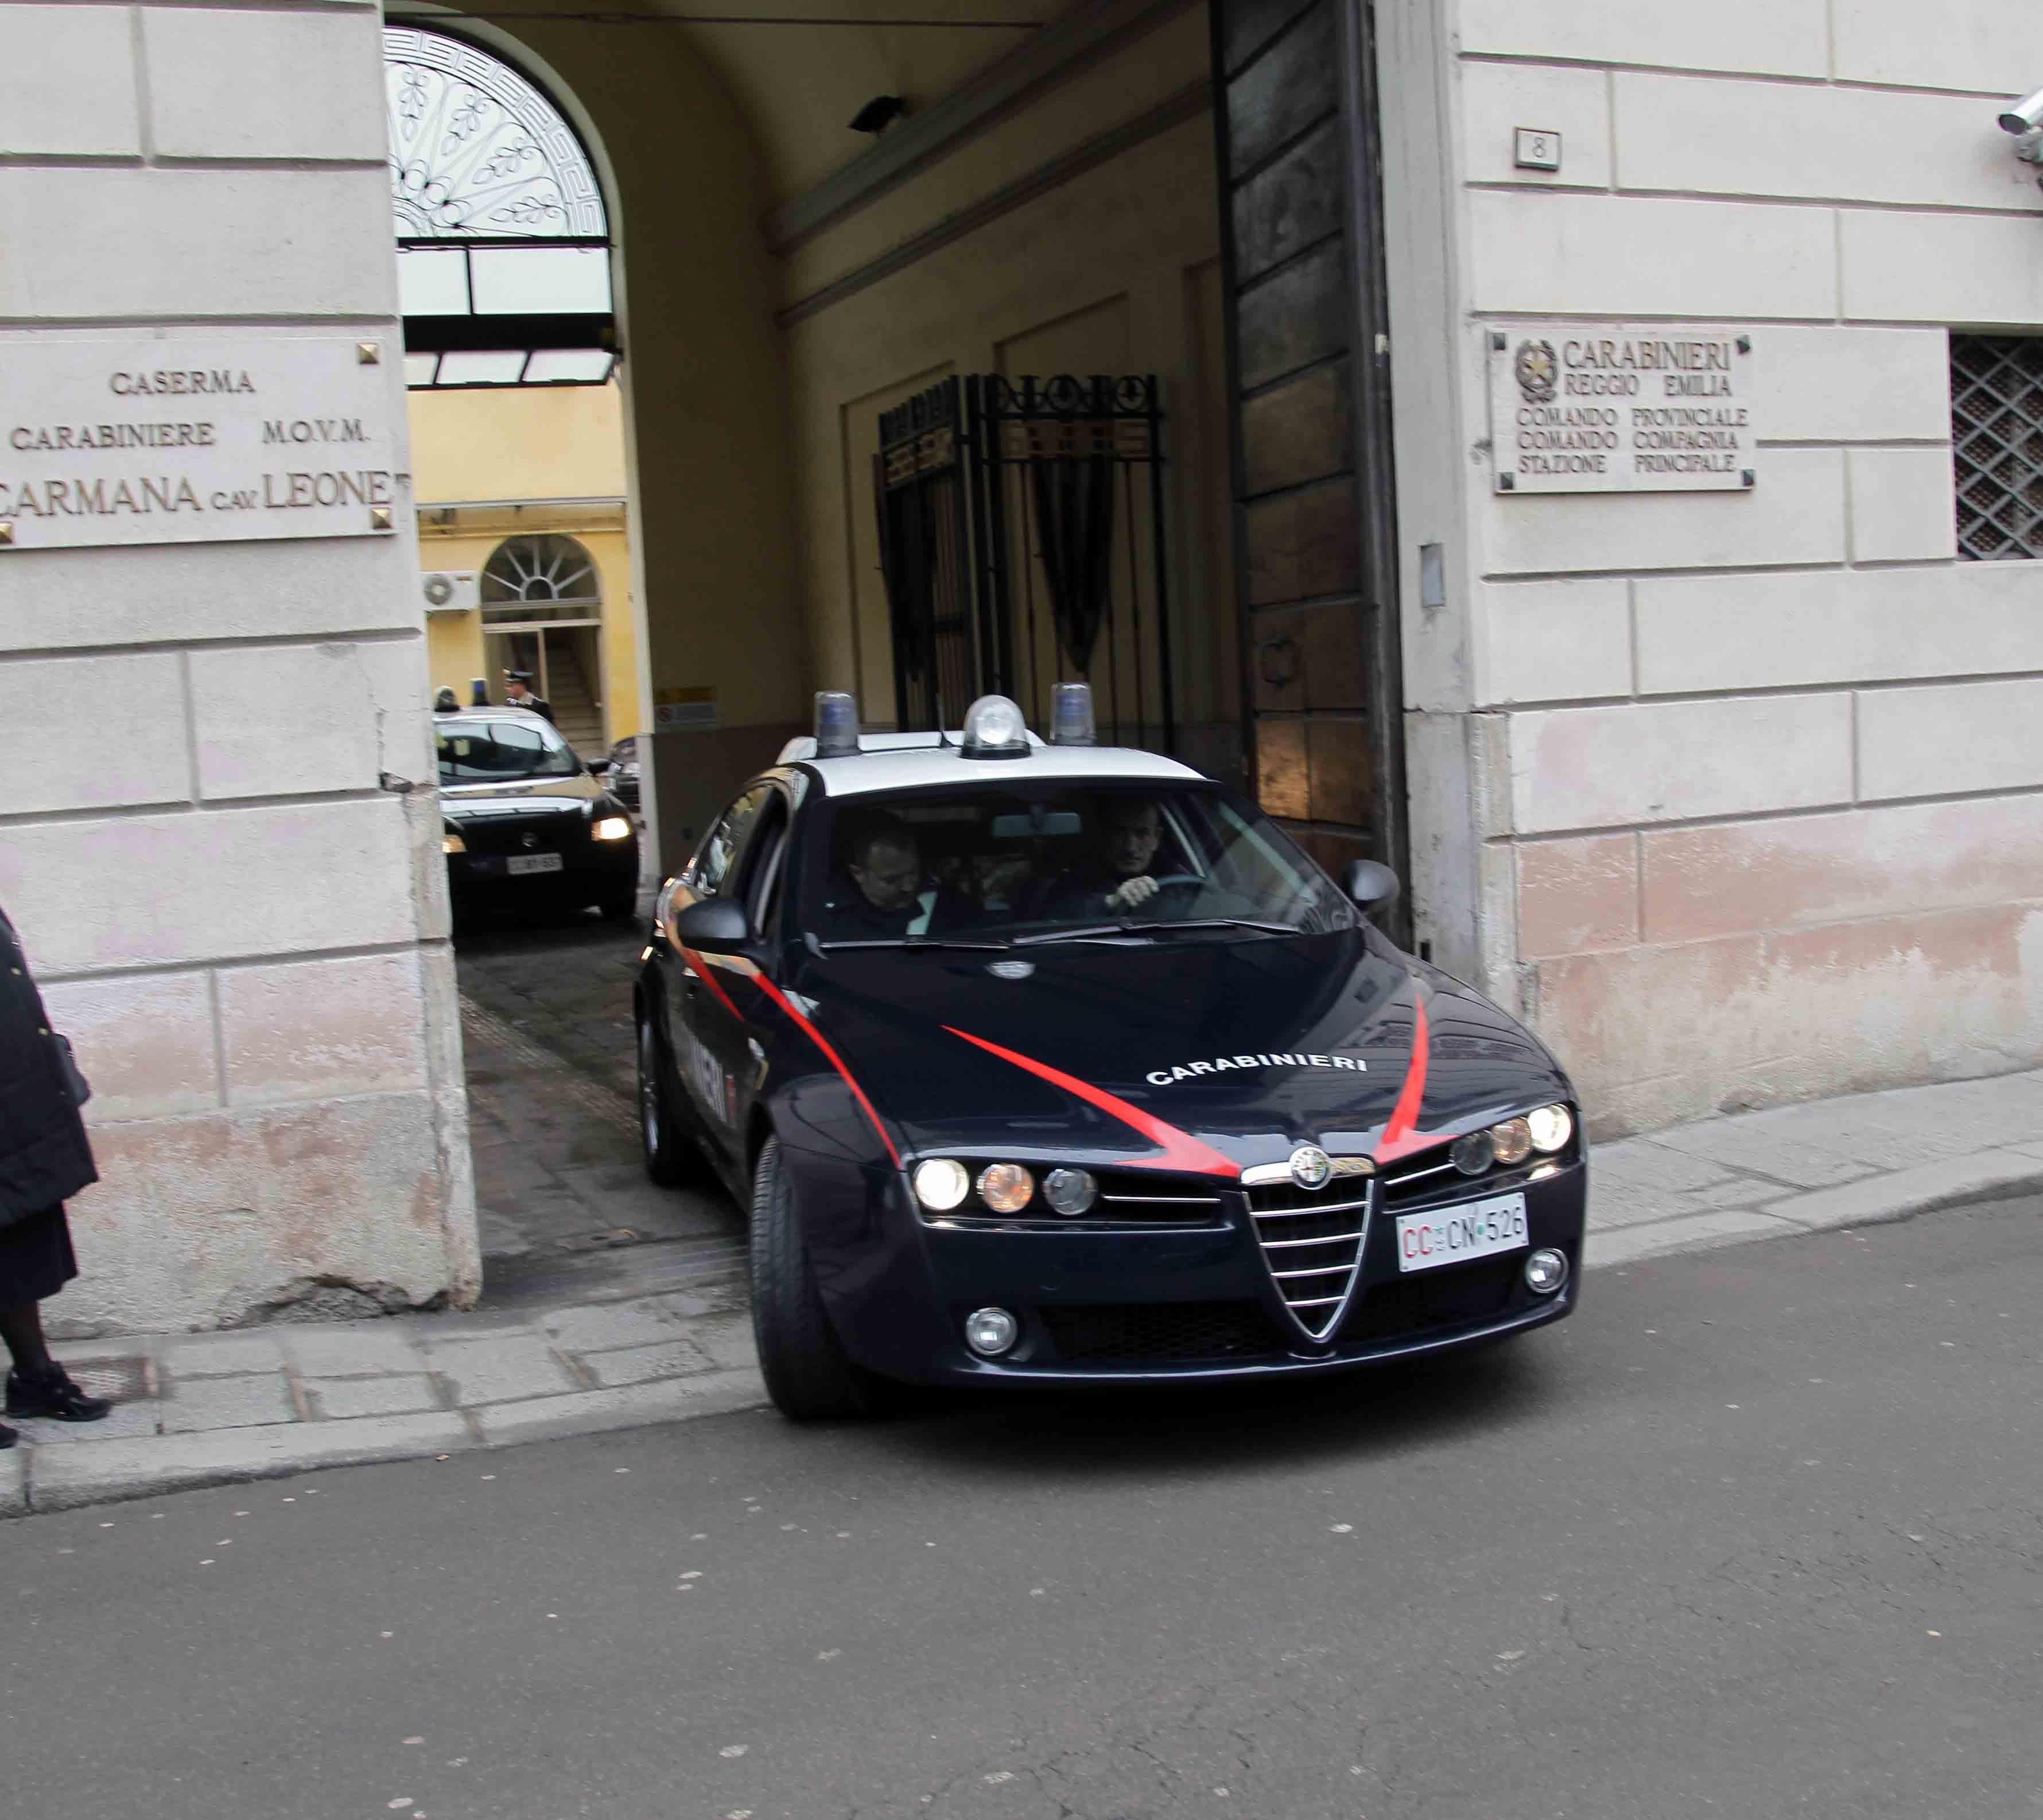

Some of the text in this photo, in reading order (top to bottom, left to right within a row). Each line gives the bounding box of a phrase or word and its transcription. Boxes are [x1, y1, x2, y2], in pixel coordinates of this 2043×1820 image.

[1533, 137, 1546, 158] 8
[1563, 340, 1731, 370] CARABINIERI
[110, 370, 255, 396] CASERMA
[1564, 373, 1732, 396] REGGIO EMILIA
[1516, 408, 1749, 427] COMANDO PROVINCIALE
[10, 422, 215, 450] CARABINIERE
[1516, 430, 1738, 450] COMANDO COMPAGNIA
[1518, 454, 1736, 473] STAZIONE PRINCIPALE
[262, 470, 393, 508] LEONE
[1146, 1052, 1368, 1086] CARABINIERI
